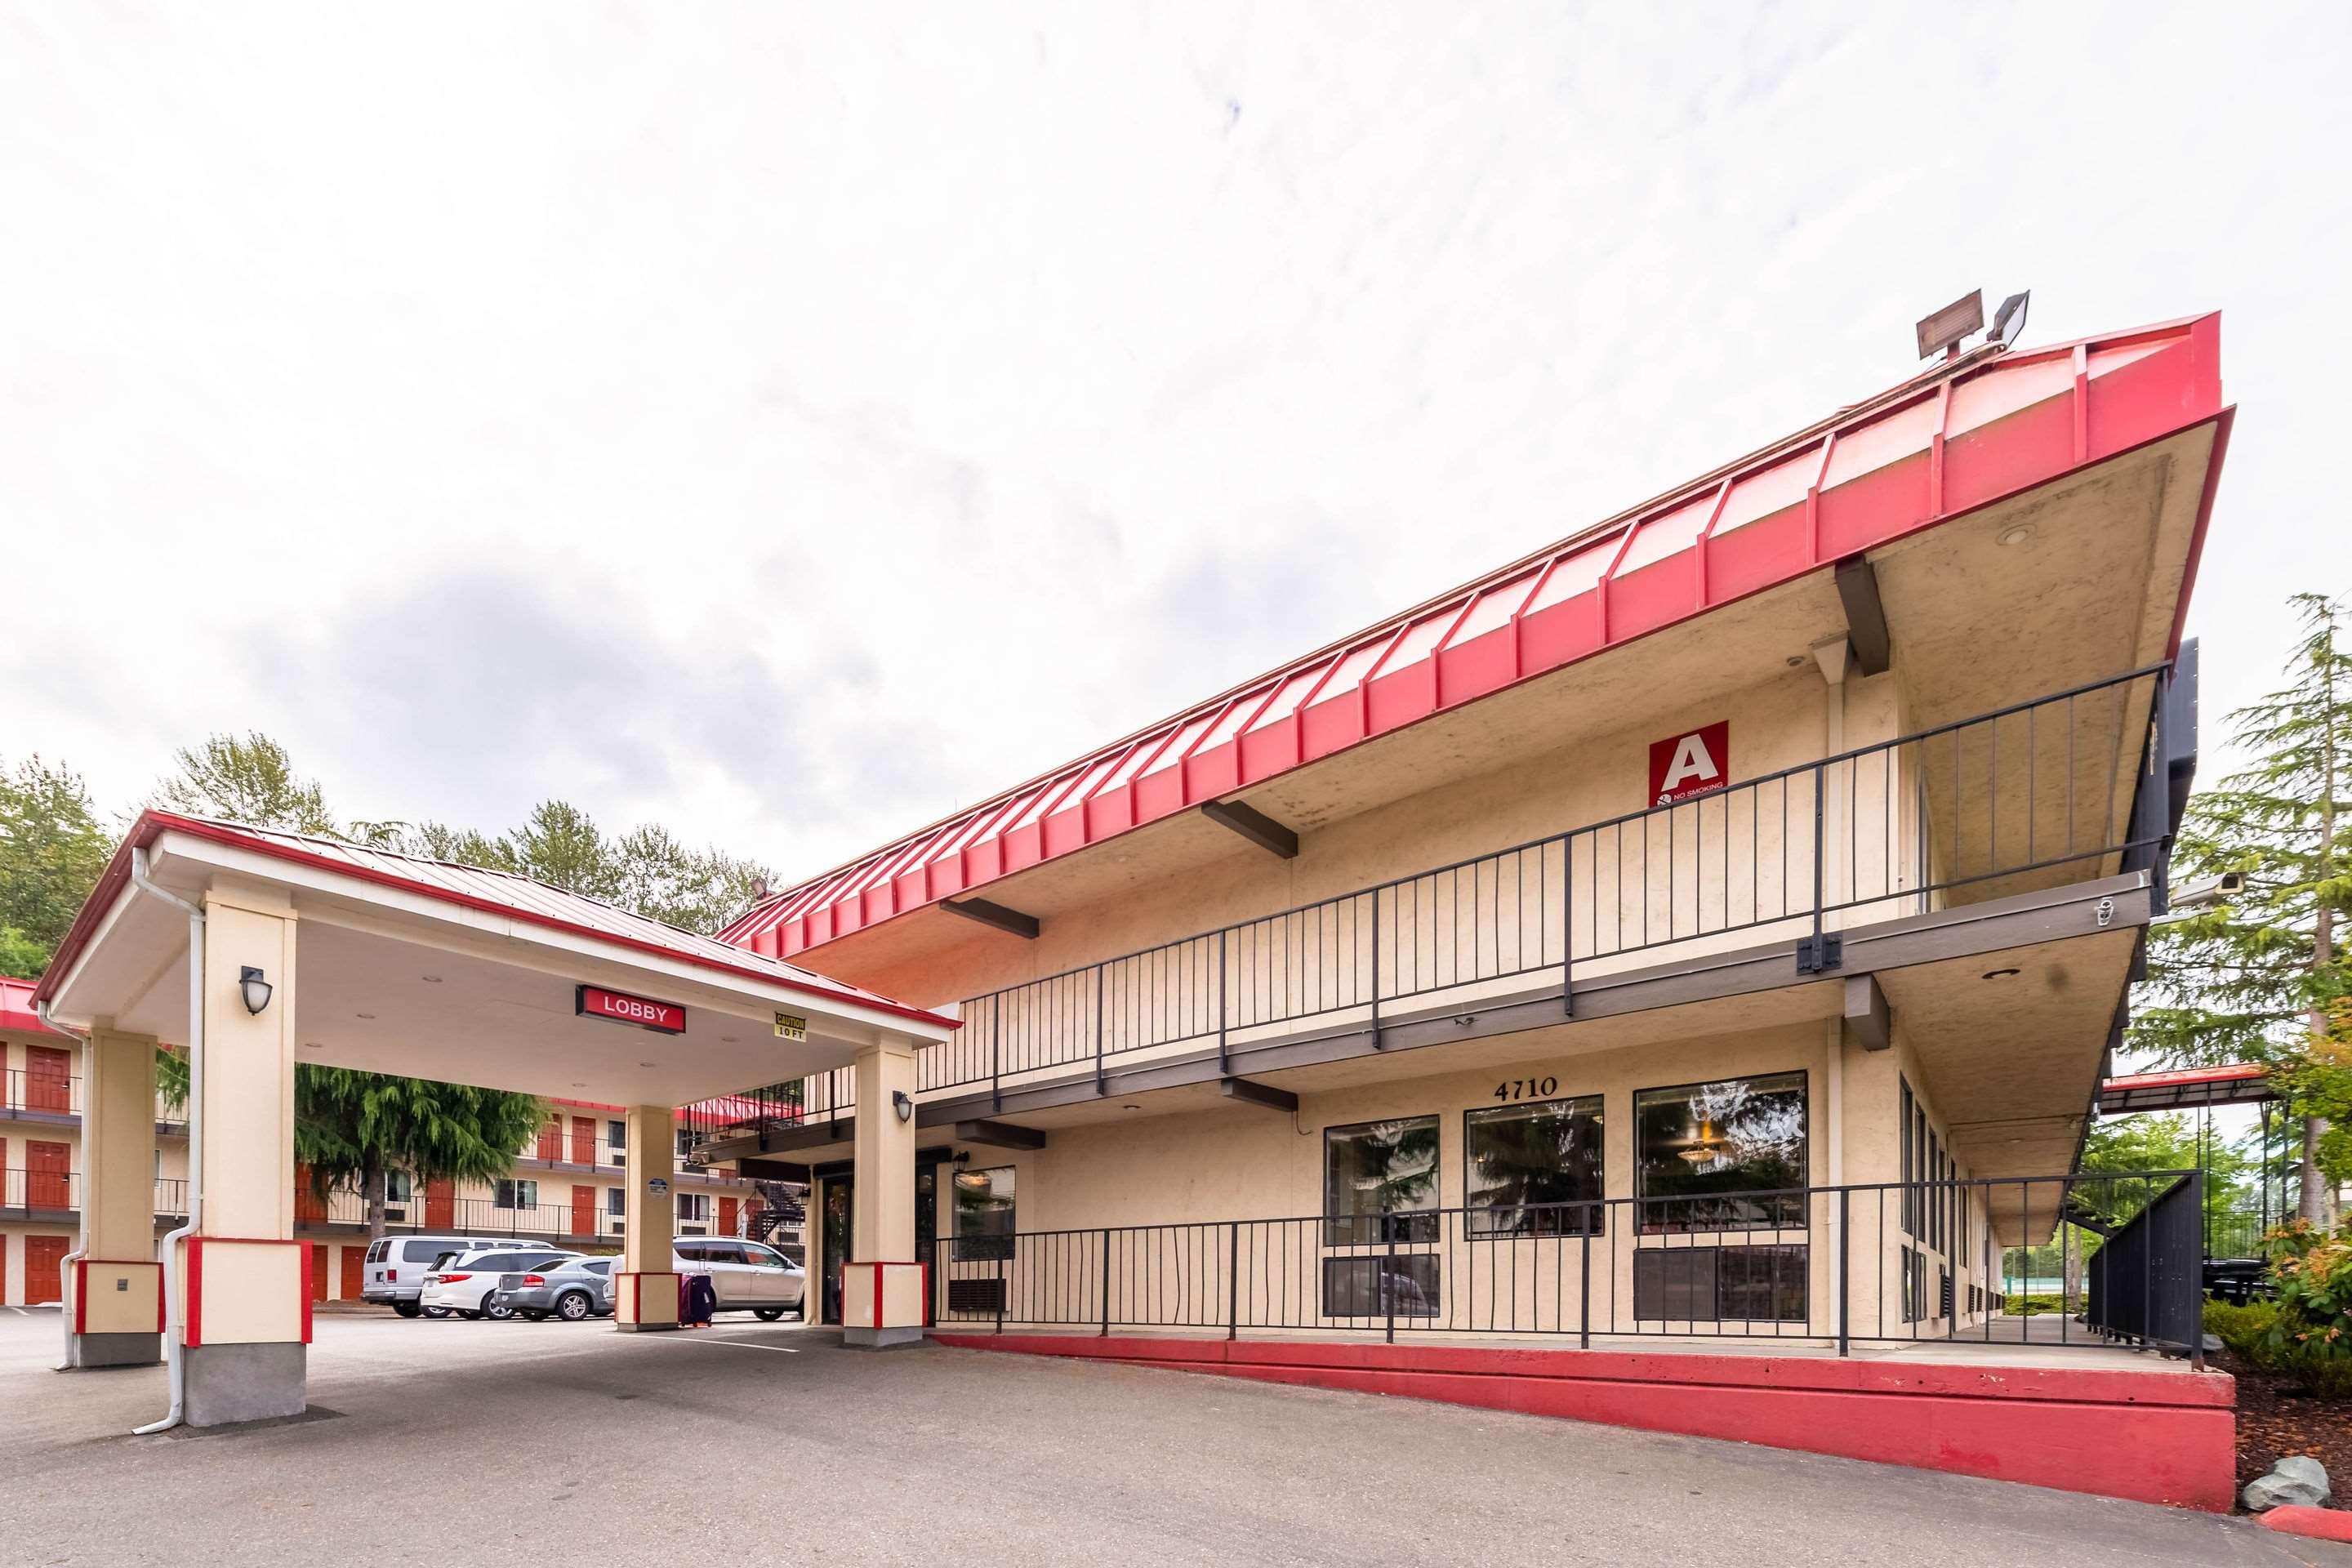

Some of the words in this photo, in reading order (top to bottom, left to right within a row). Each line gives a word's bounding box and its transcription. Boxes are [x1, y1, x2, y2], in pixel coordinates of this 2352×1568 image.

[1660, 733, 1719, 792] A
[1673, 792, 1686, 800] NO
[1686, 782, 1723, 797] SMOKING
[604, 996, 667, 1022] LOBBY
[777, 1014, 804, 1029] CAUTION
[1494, 1077, 1557, 1102] 4710
